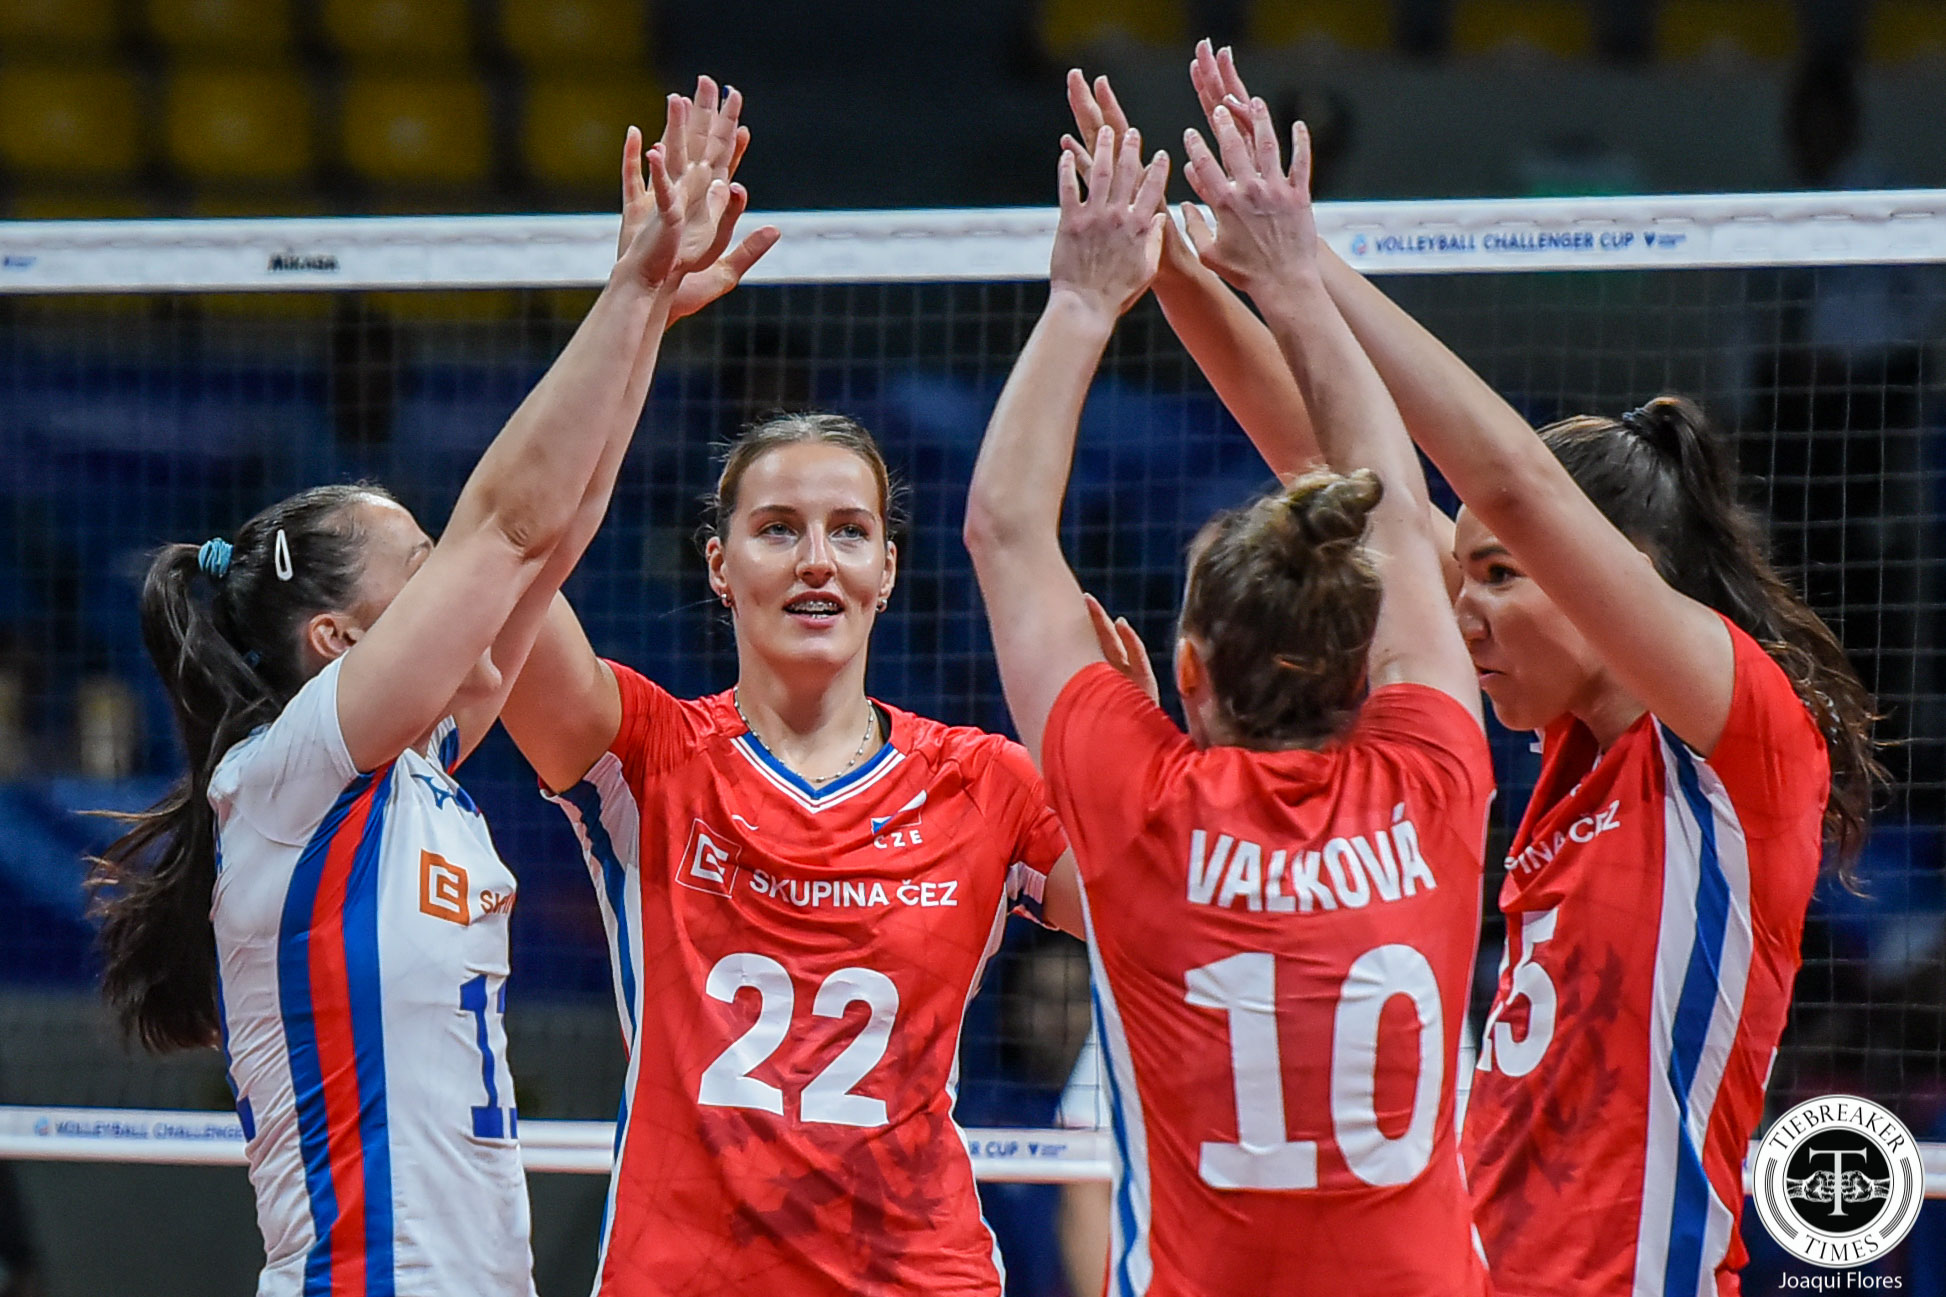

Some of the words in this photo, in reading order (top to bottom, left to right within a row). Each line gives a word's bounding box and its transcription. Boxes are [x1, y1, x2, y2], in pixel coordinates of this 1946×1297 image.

[1375, 234, 1476, 252] VOLLEYBALL
[1484, 232, 1594, 251] CHALLENGER
[1600, 231, 1634, 250] CUP
[873, 829, 923, 850] CZE
[1187, 802, 1437, 913] VALKOVÁ
[749, 869, 890, 908] SKUPINA
[896, 879, 958, 907] ČEZ
[698, 952, 899, 1127] 22
[1184, 944, 1444, 1190] 10
[985, 1141, 1018, 1157] CUP
